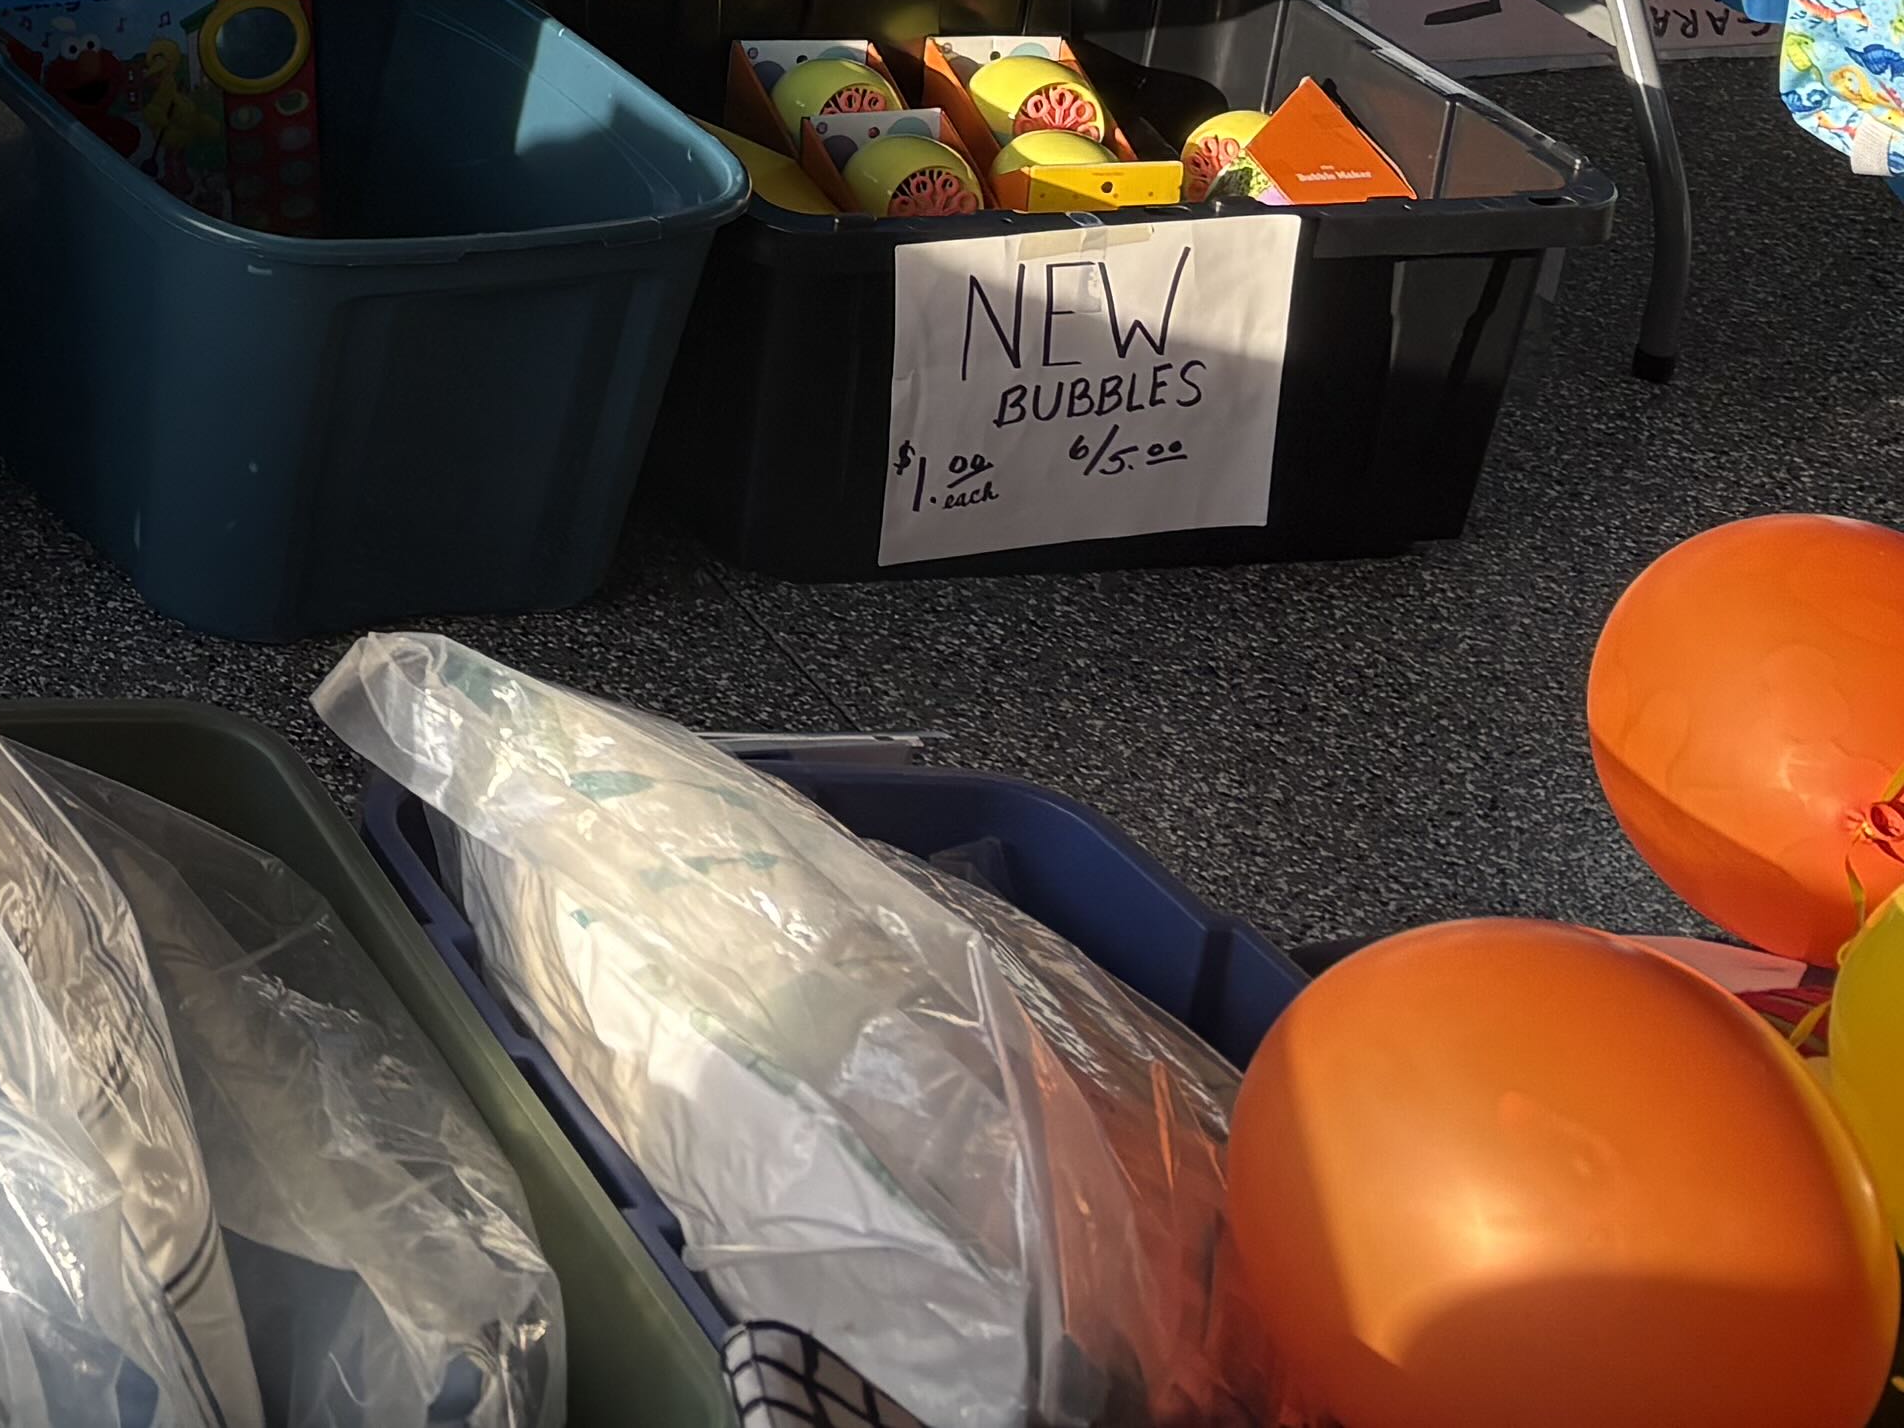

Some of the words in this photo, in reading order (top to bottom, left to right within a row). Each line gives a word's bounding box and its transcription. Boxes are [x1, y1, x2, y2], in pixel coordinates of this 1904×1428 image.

[961, 245, 1192, 382] NEW
[992, 359, 1208, 428] BUBBLES
[941, 480, 1000, 510] each
